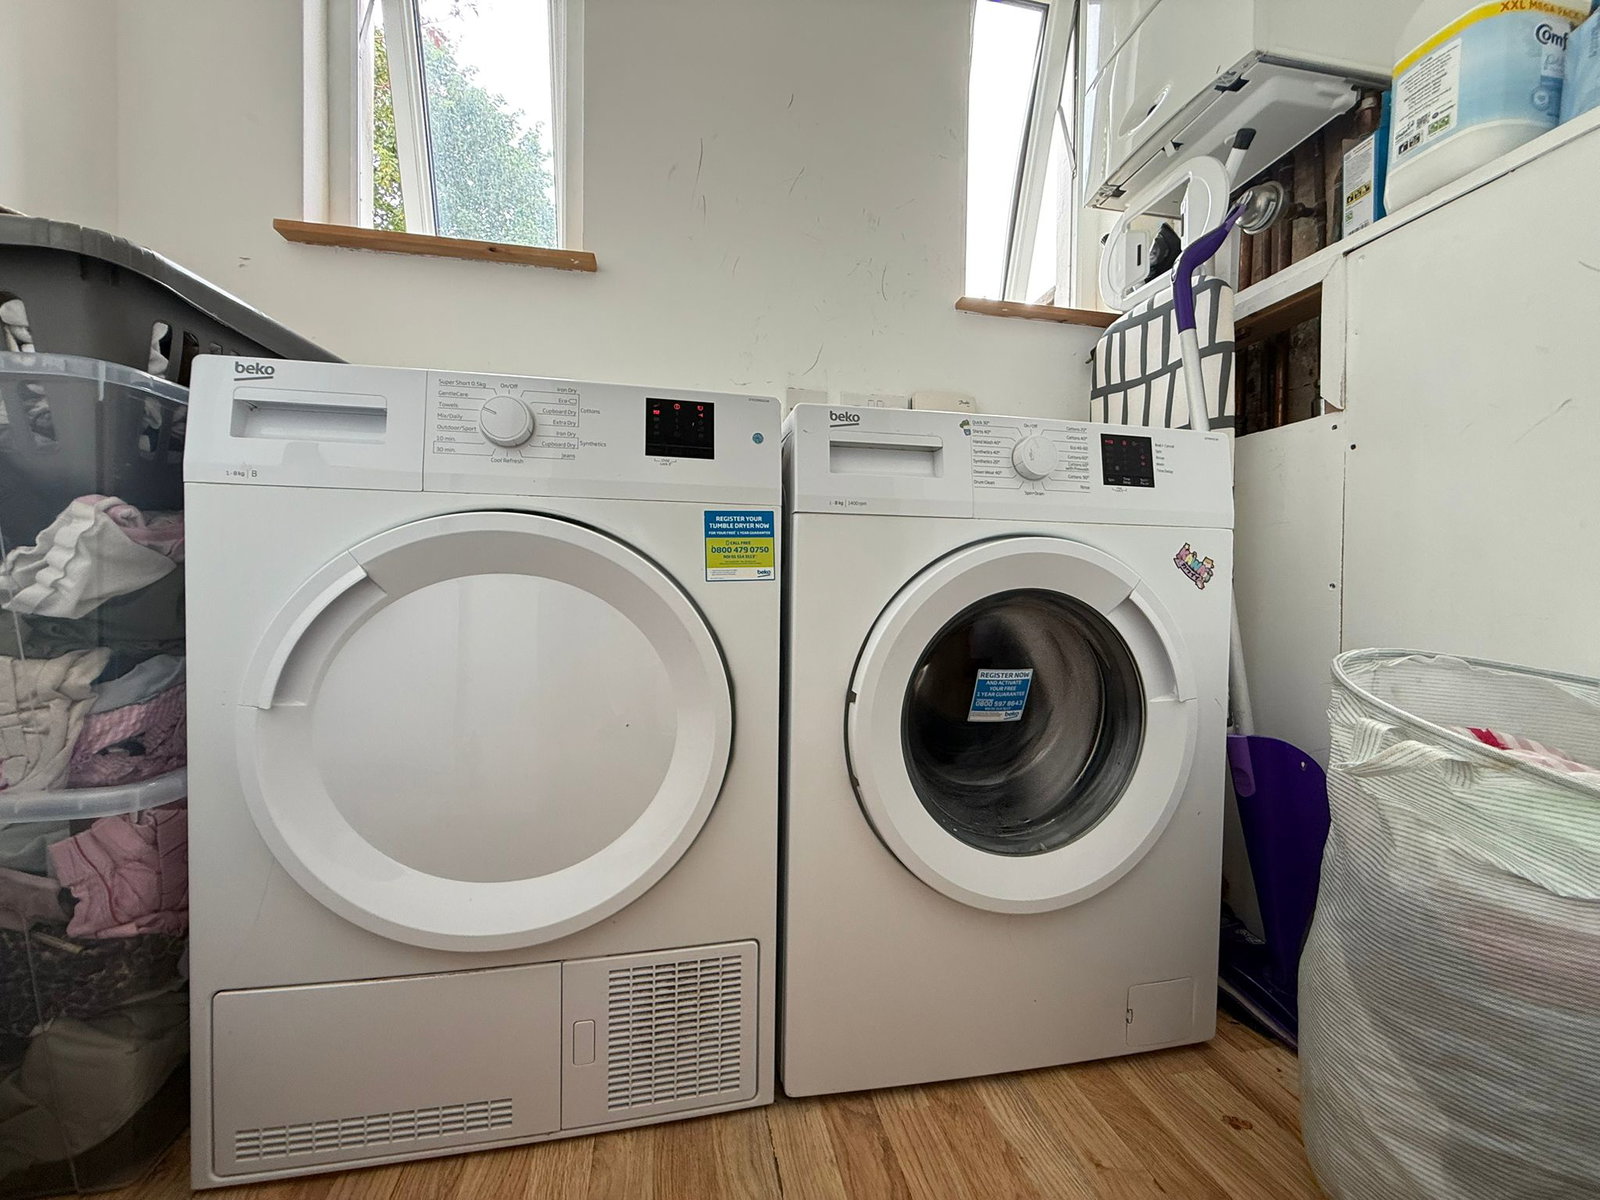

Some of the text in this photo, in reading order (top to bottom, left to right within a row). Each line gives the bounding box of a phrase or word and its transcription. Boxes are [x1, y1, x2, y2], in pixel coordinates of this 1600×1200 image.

[1500, 0, 1526, 12] XXL
[1529, 0, 1555, 12] MEGA
[234, 361, 275, 375] beko
[830, 410, 860, 422] beko
[711, 546, 732, 554] 0800
